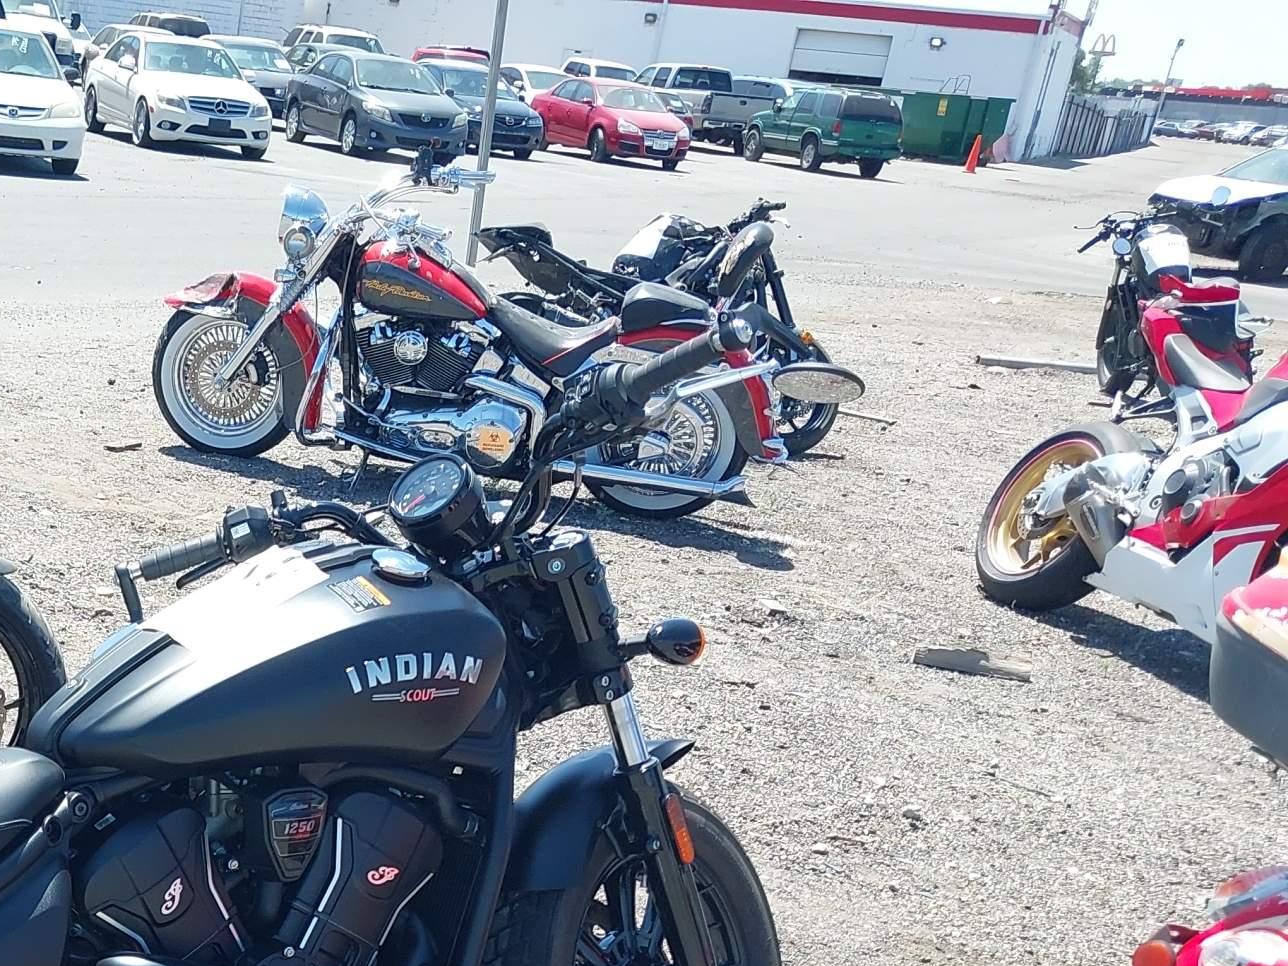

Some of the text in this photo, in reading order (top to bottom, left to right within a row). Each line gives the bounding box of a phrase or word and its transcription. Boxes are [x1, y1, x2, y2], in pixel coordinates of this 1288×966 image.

[345, 652, 483, 694] INDIAN
[399, 688, 437, 703] SCOUT
[284, 819, 316, 835] 1250
